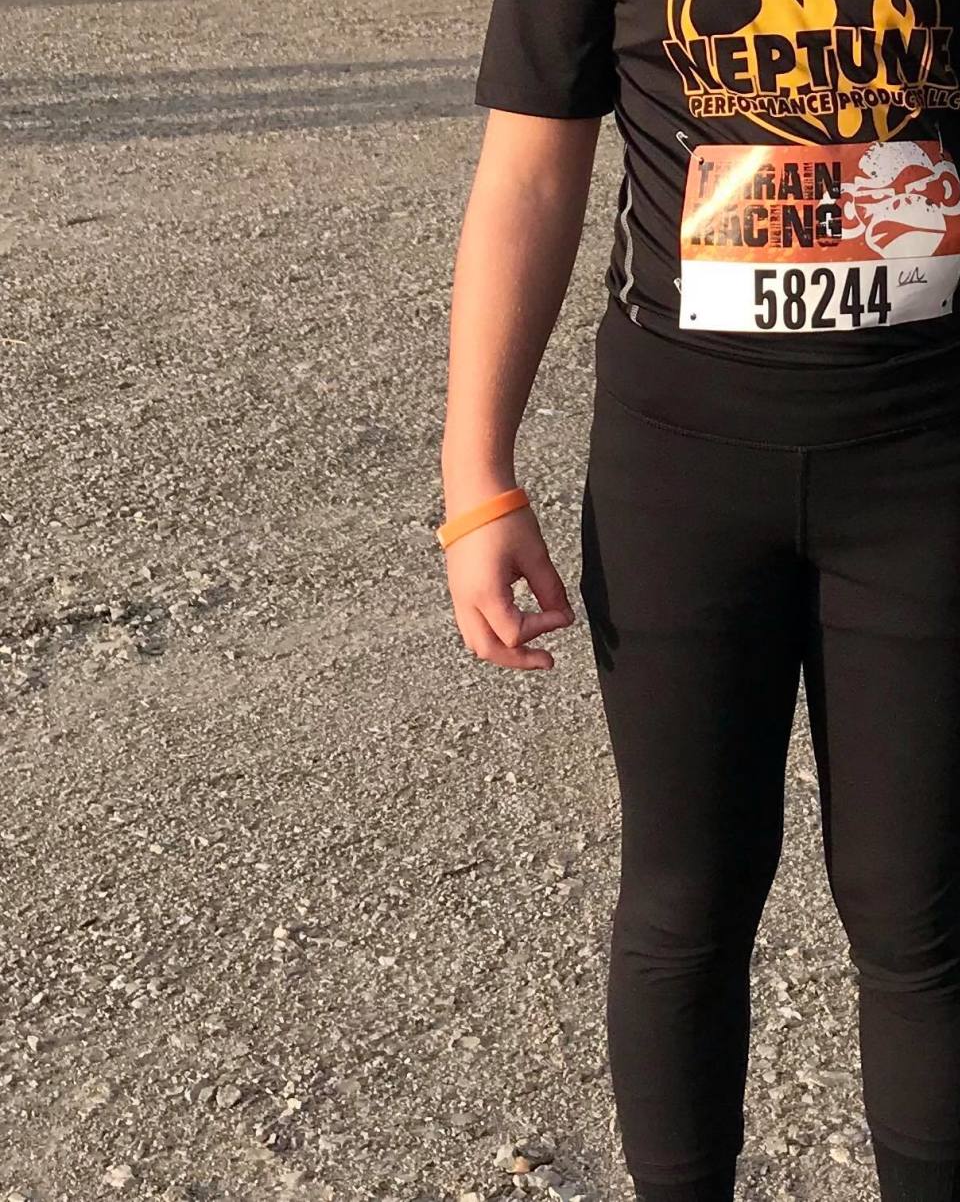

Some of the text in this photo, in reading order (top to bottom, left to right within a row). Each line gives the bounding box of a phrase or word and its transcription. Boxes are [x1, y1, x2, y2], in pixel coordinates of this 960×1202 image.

[663, 25, 960, 96] NEPTUNE
[698, 161, 842, 201] TRAIN
[753, 265, 892, 330] 58244
